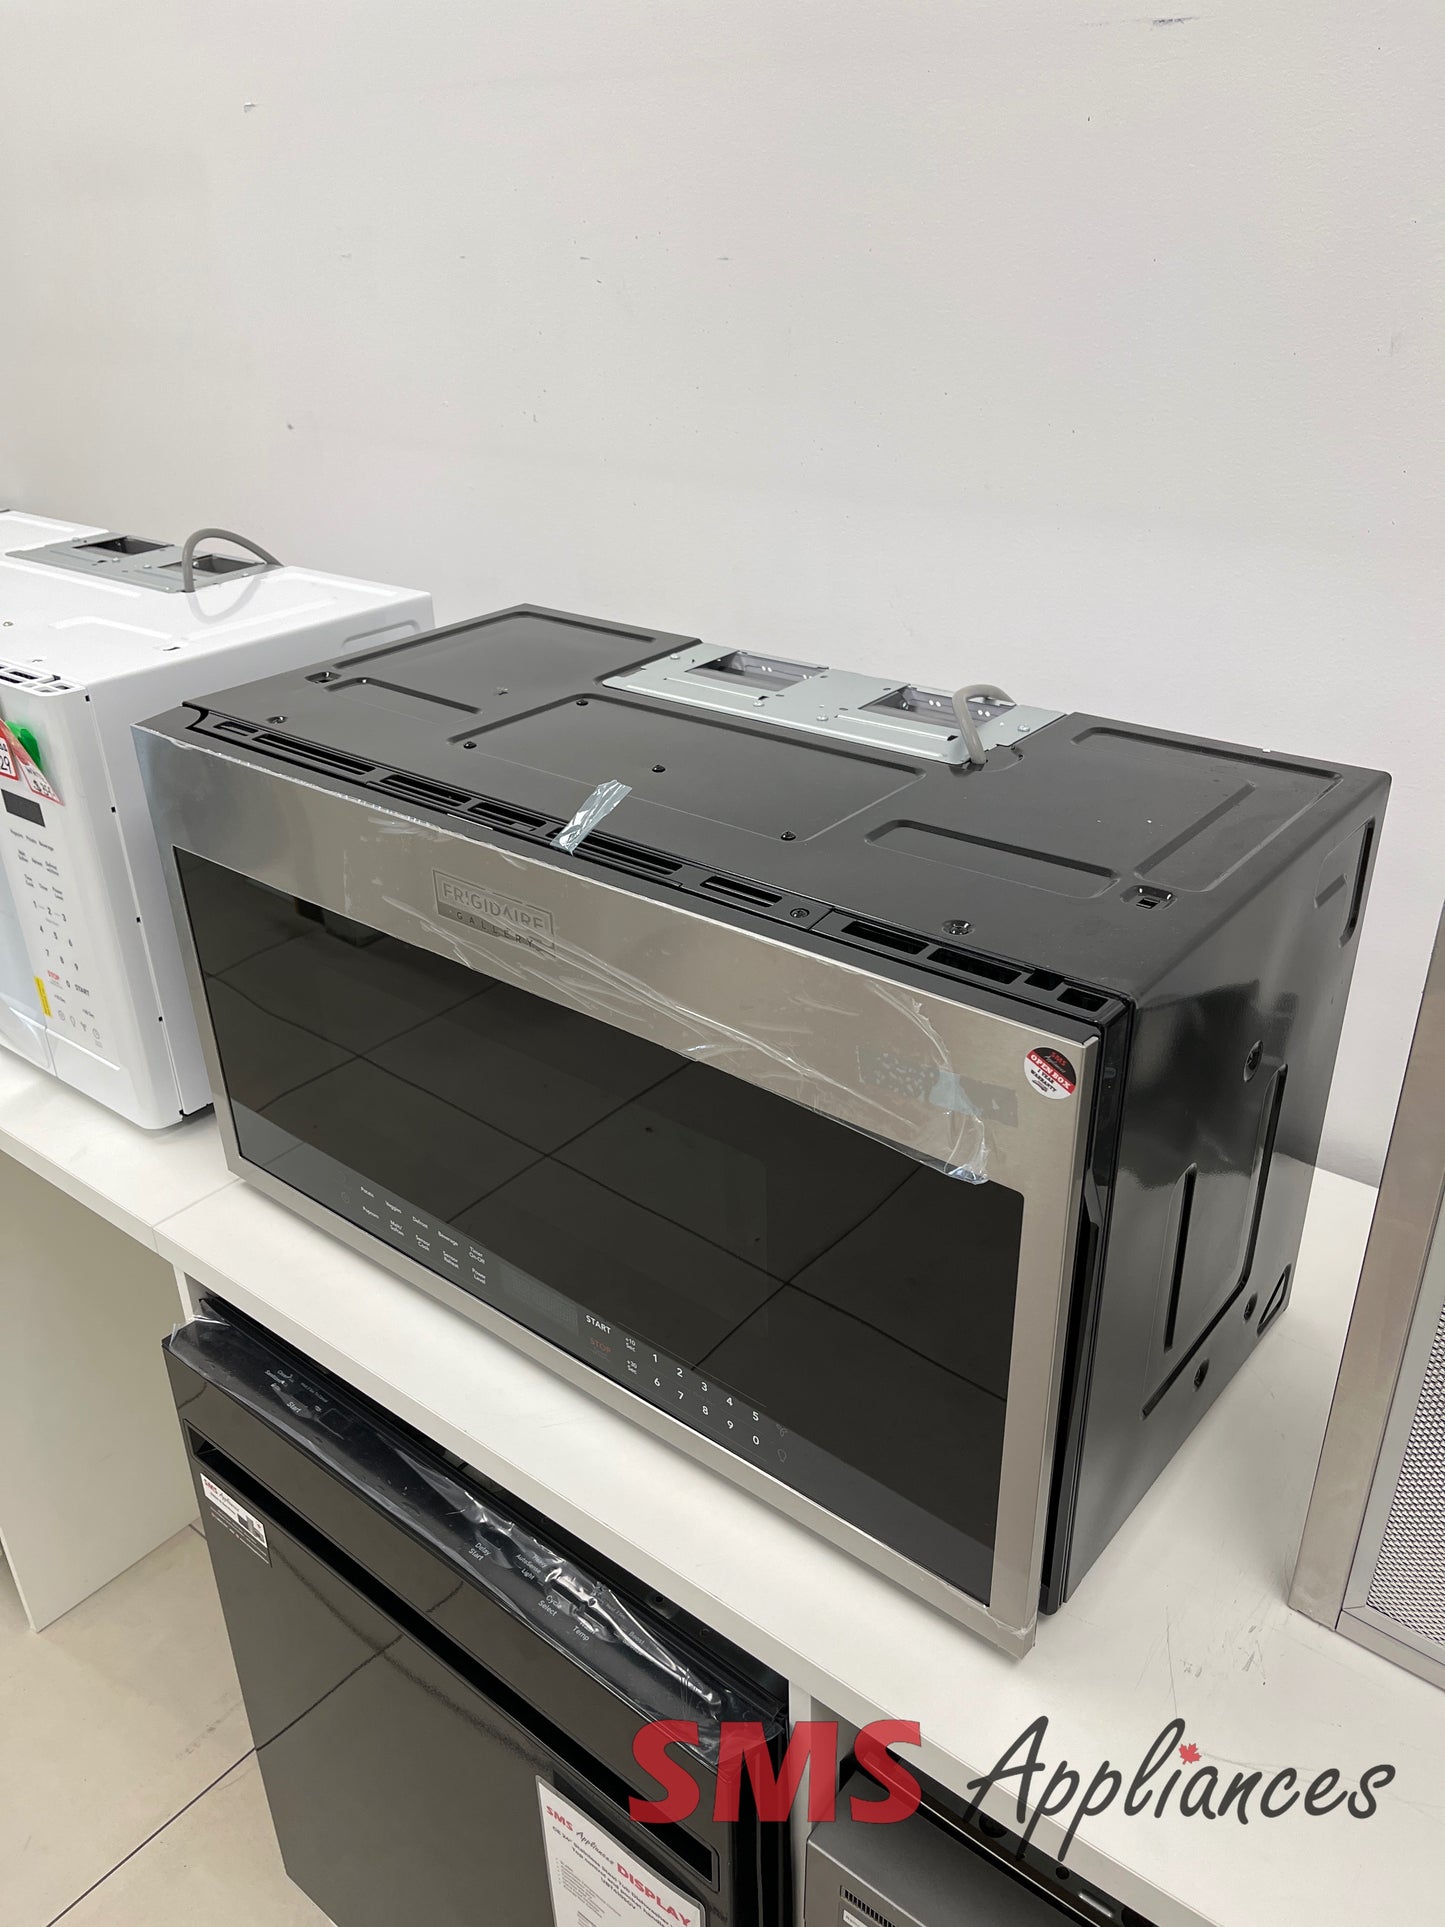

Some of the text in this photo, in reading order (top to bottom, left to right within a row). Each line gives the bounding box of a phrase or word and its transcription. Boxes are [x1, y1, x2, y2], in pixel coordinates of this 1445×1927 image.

[442, 882, 545, 929] FRIGIDAIRE
[455, 911, 534, 948] GALLERY
[74, 983, 90, 997] START
[1030, 1054, 1053, 1075] OPEN
[1052, 1070, 1072, 1090] BOX
[585, 1314, 612, 1335] START
[589, 1337, 613, 1354] STOP
[652, 1353, 760, 1421] 1 2 3 4 5
[286, 1401, 302, 1415] Start
[653, 1378, 760, 1445] 6 7 8 9 0
[468, 1548, 484, 1562] Start
[475, 1541, 491, 1557] Delay
[515, 1553, 542, 1574] AutoSense
[521, 1568, 536, 1581] Light
[537, 1600, 558, 1617] Select
[545, 1594, 563, 1611] Cycle
[572, 1625, 591, 1642] Temp
[546, 1805, 574, 1832] SMS
[576, 1831, 615, 1865] Appliances
[616, 1862, 691, 1927] DISPLAY
